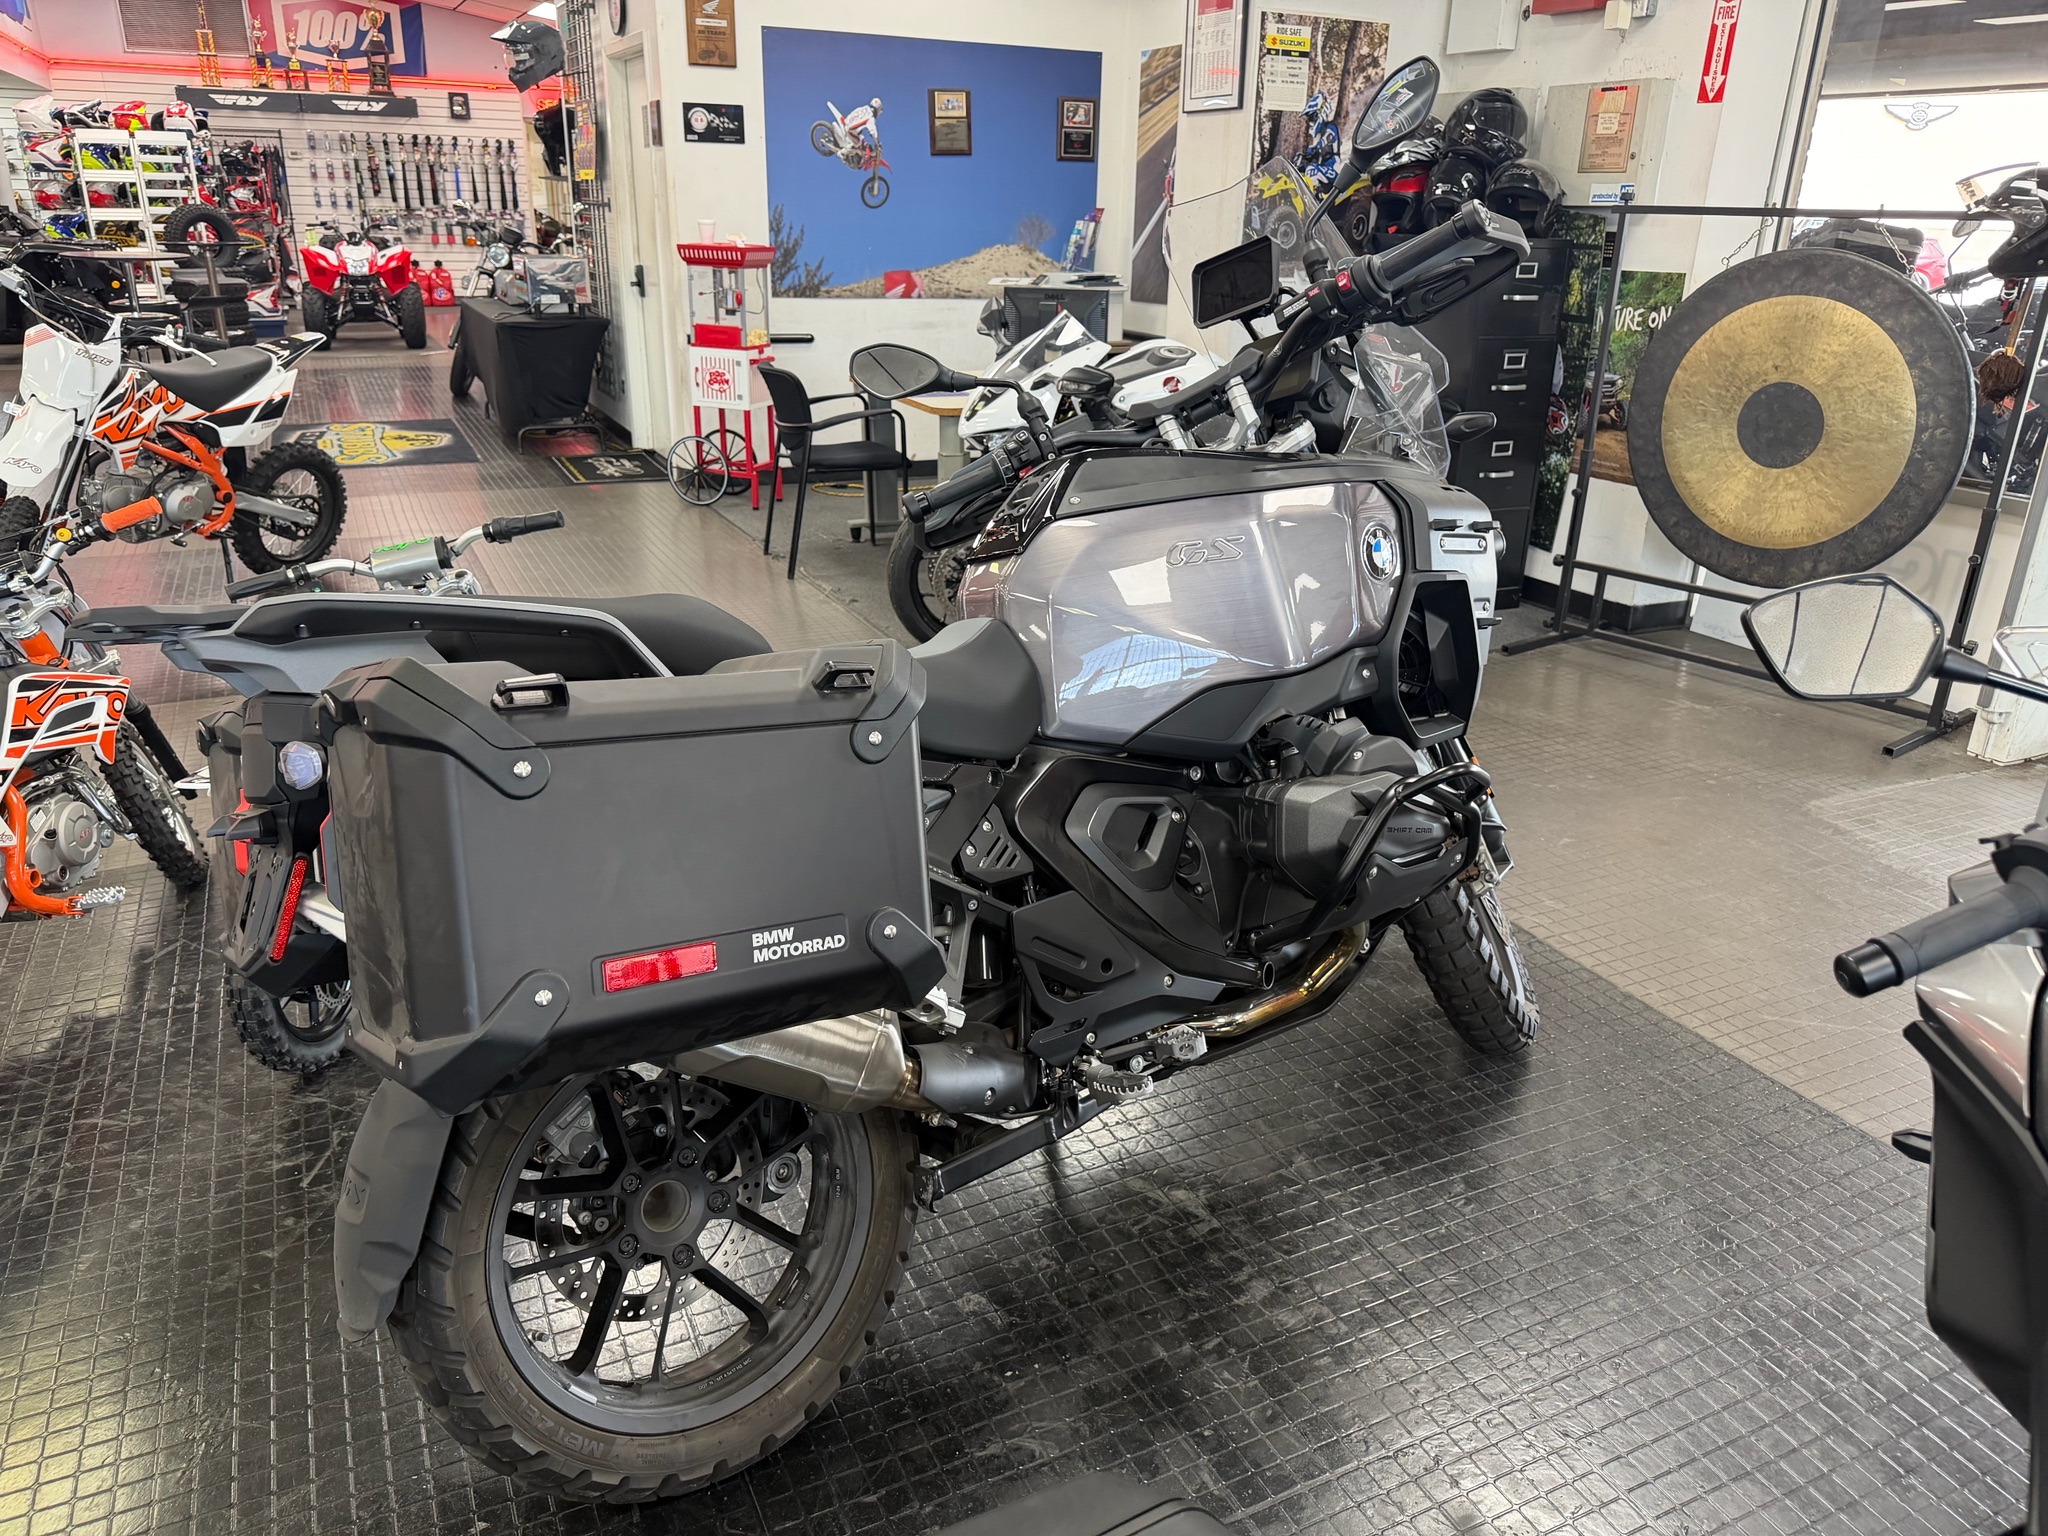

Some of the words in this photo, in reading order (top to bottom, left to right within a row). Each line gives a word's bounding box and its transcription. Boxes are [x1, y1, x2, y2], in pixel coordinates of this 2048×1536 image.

[1717, 5, 1737, 20] FIRE
[1276, 26, 1289, 35] RIDE
[1289, 27, 1302, 37] SAFE
[1279, 39, 1306, 47] SUZUKI
[1709, 22, 1727, 93] EXTINGUISHER
[1043, 293, 1065, 301] DELL
[708, 377, 729, 386] CORN
[709, 370, 726, 379] POP
[329, 422, 389, 464] STUBBS
[1165, 535, 1245, 568] GS
[1387, 826, 1413, 834] SHIFT
[751, 926, 795, 948] BMW
[753, 934, 846, 964] MOTORRAD
[490, 1362, 605, 1458] METZELER
